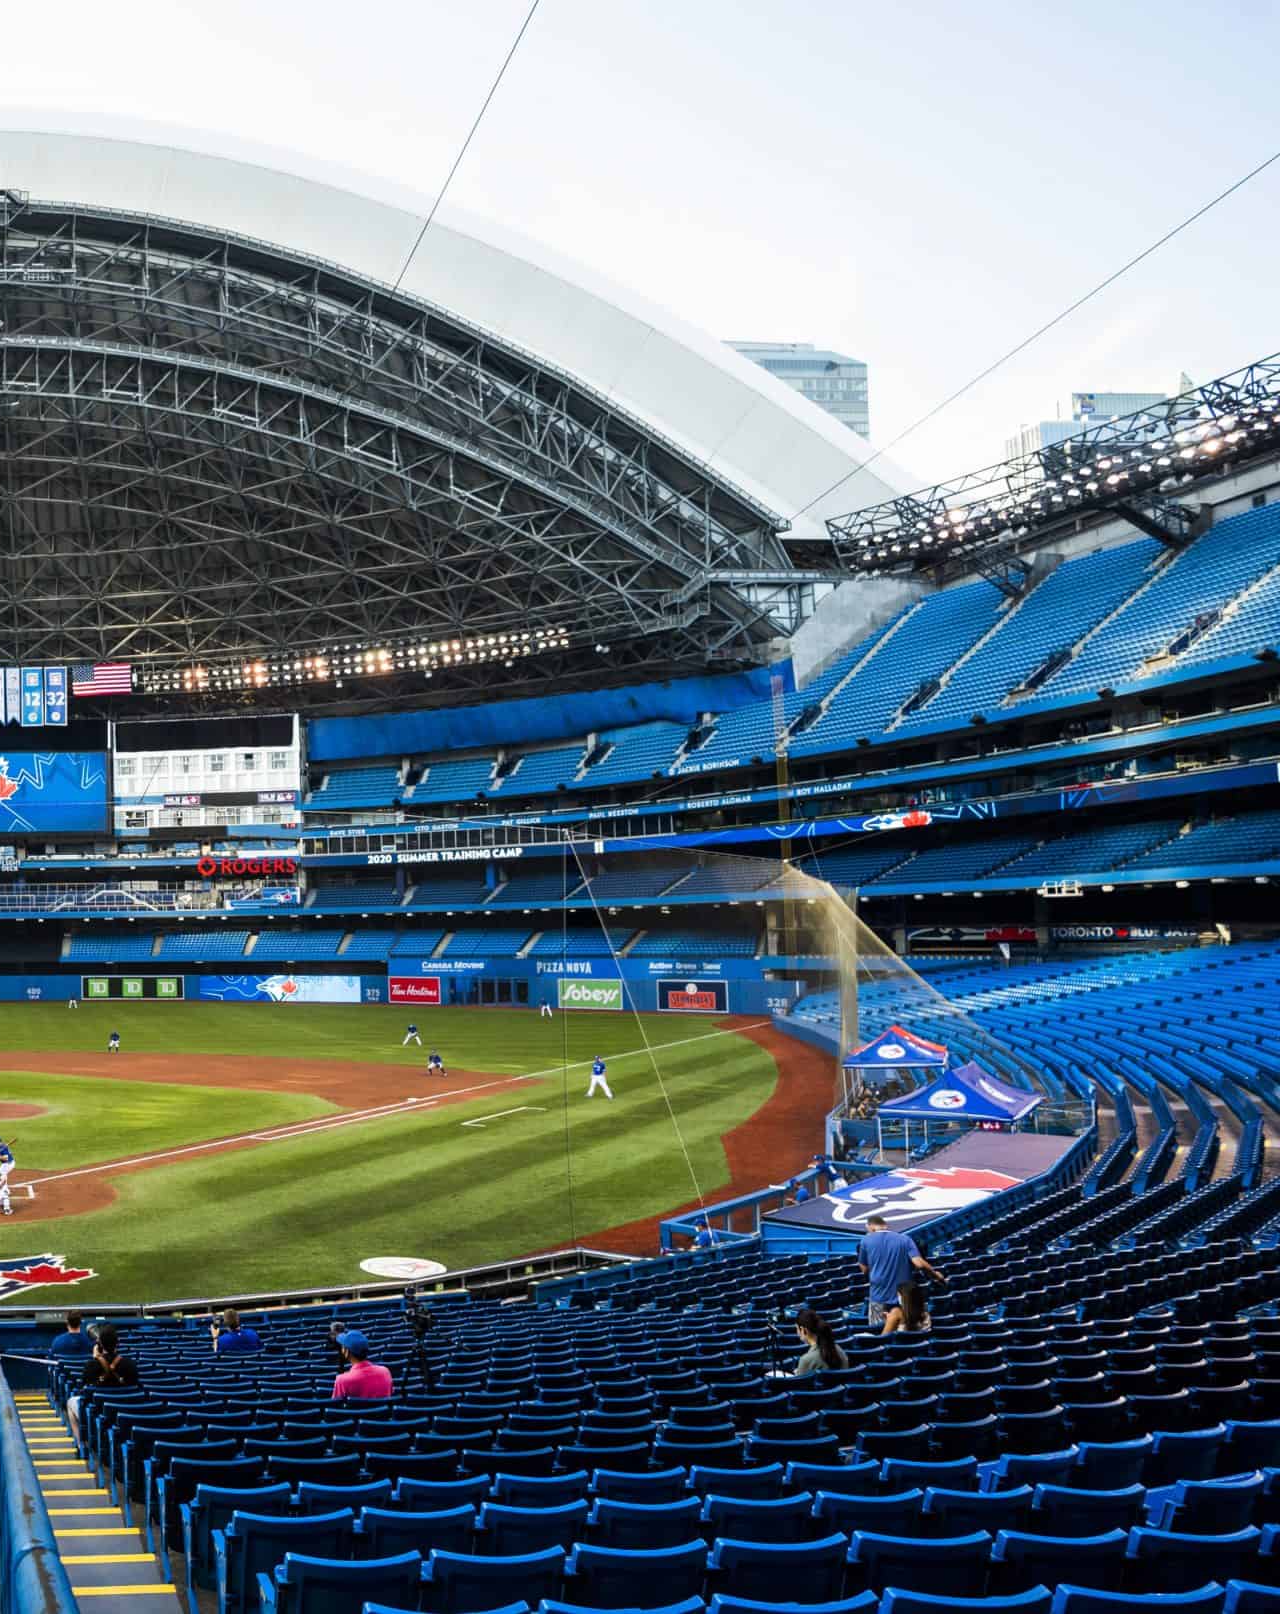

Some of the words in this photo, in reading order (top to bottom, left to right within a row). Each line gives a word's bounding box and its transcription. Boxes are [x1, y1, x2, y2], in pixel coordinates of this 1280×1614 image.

[24, 692, 40, 706] 12
[46, 692, 65, 706] 32
[814, 782, 853, 794] HALLADAY
[367, 854, 392, 864] 2020
[397, 852, 440, 864] SUMMER
[440, 850, 490, 862] TRAINING
[492, 848, 523, 858] CAMP
[221, 857, 296, 874] ROGERS
[1053, 927, 1113, 937] TORONTO
[536, 961, 563, 974] PIZZA
[566, 961, 592, 974] NOVA
[90, 981, 105, 993] TD
[124, 981, 140, 993] TD
[158, 981, 174, 993] TD
[391, 984, 406, 996] Tim
[407, 984, 438, 997] Hortons
[561, 983, 619, 1004] Sobeys
